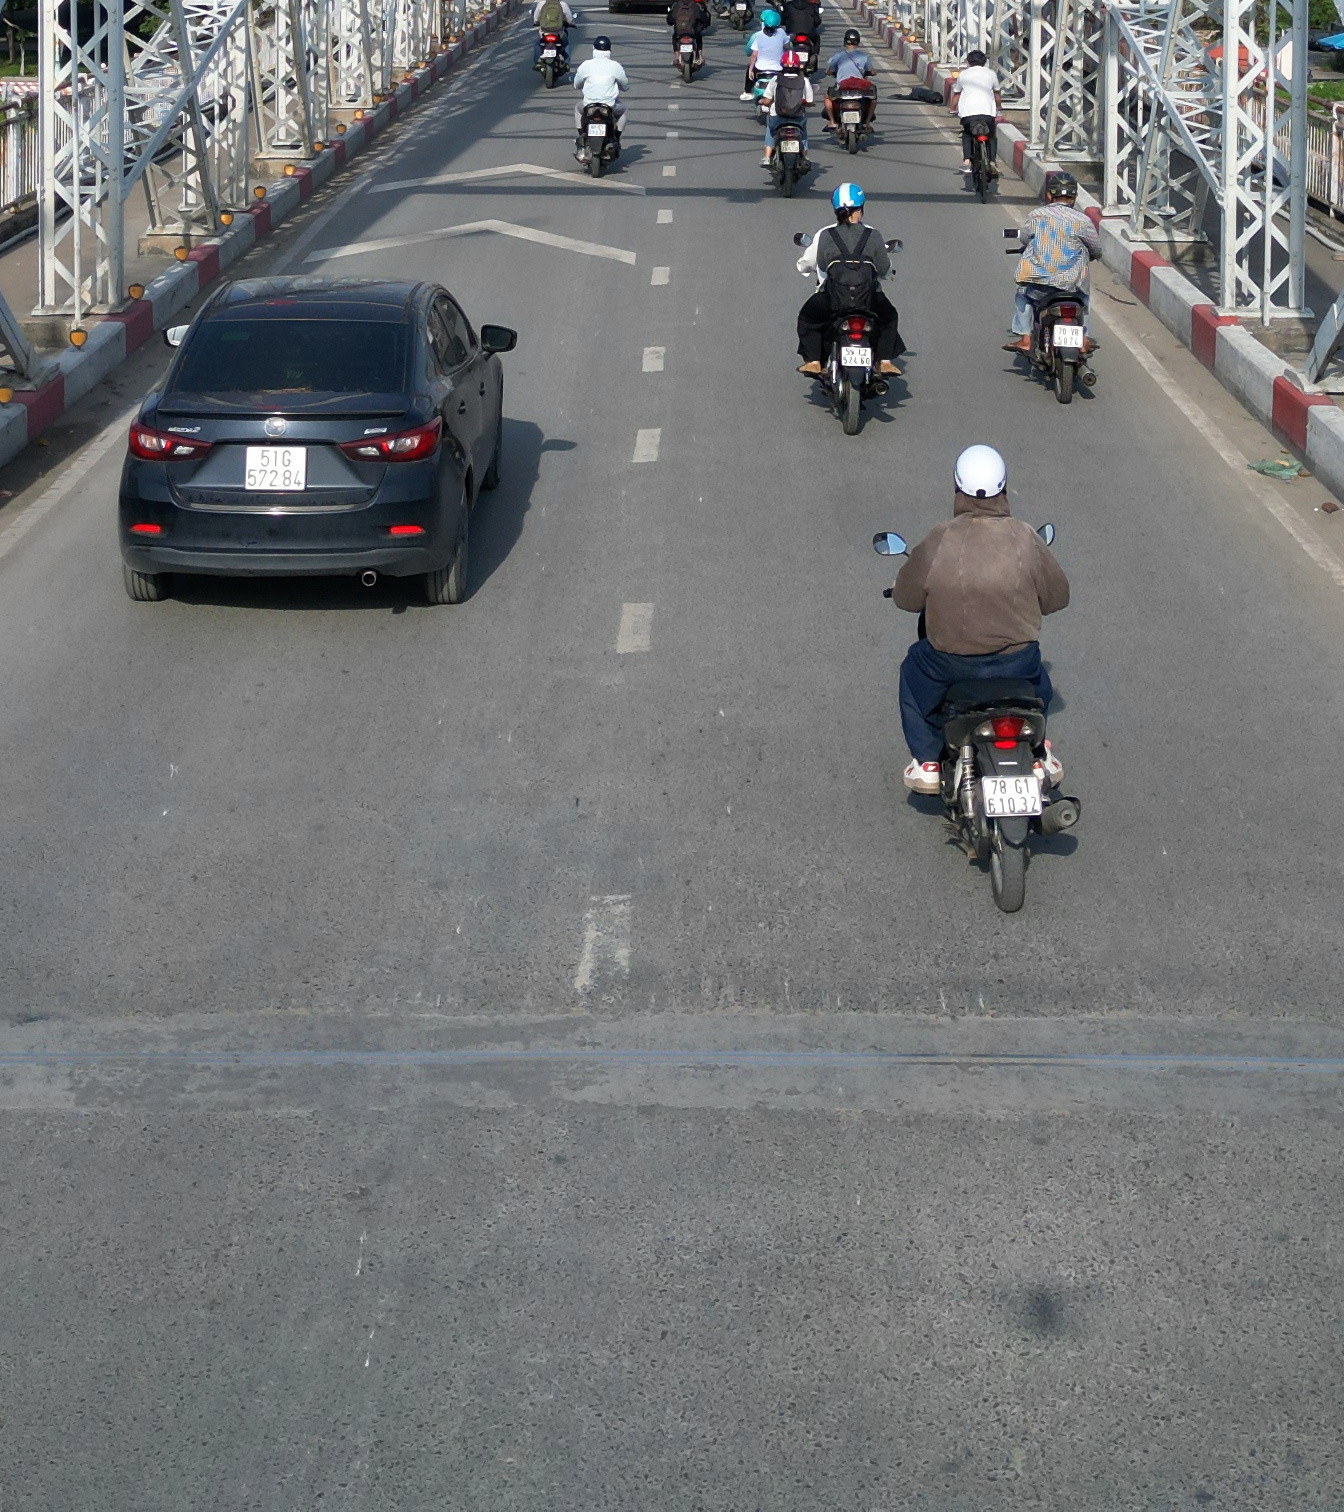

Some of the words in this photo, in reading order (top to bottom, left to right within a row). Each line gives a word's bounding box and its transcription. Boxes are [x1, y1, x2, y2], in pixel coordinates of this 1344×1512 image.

[260, 449, 292, 467] 51G
[990, 779, 1007, 795] 78
[1014, 778, 1030, 794] G1
